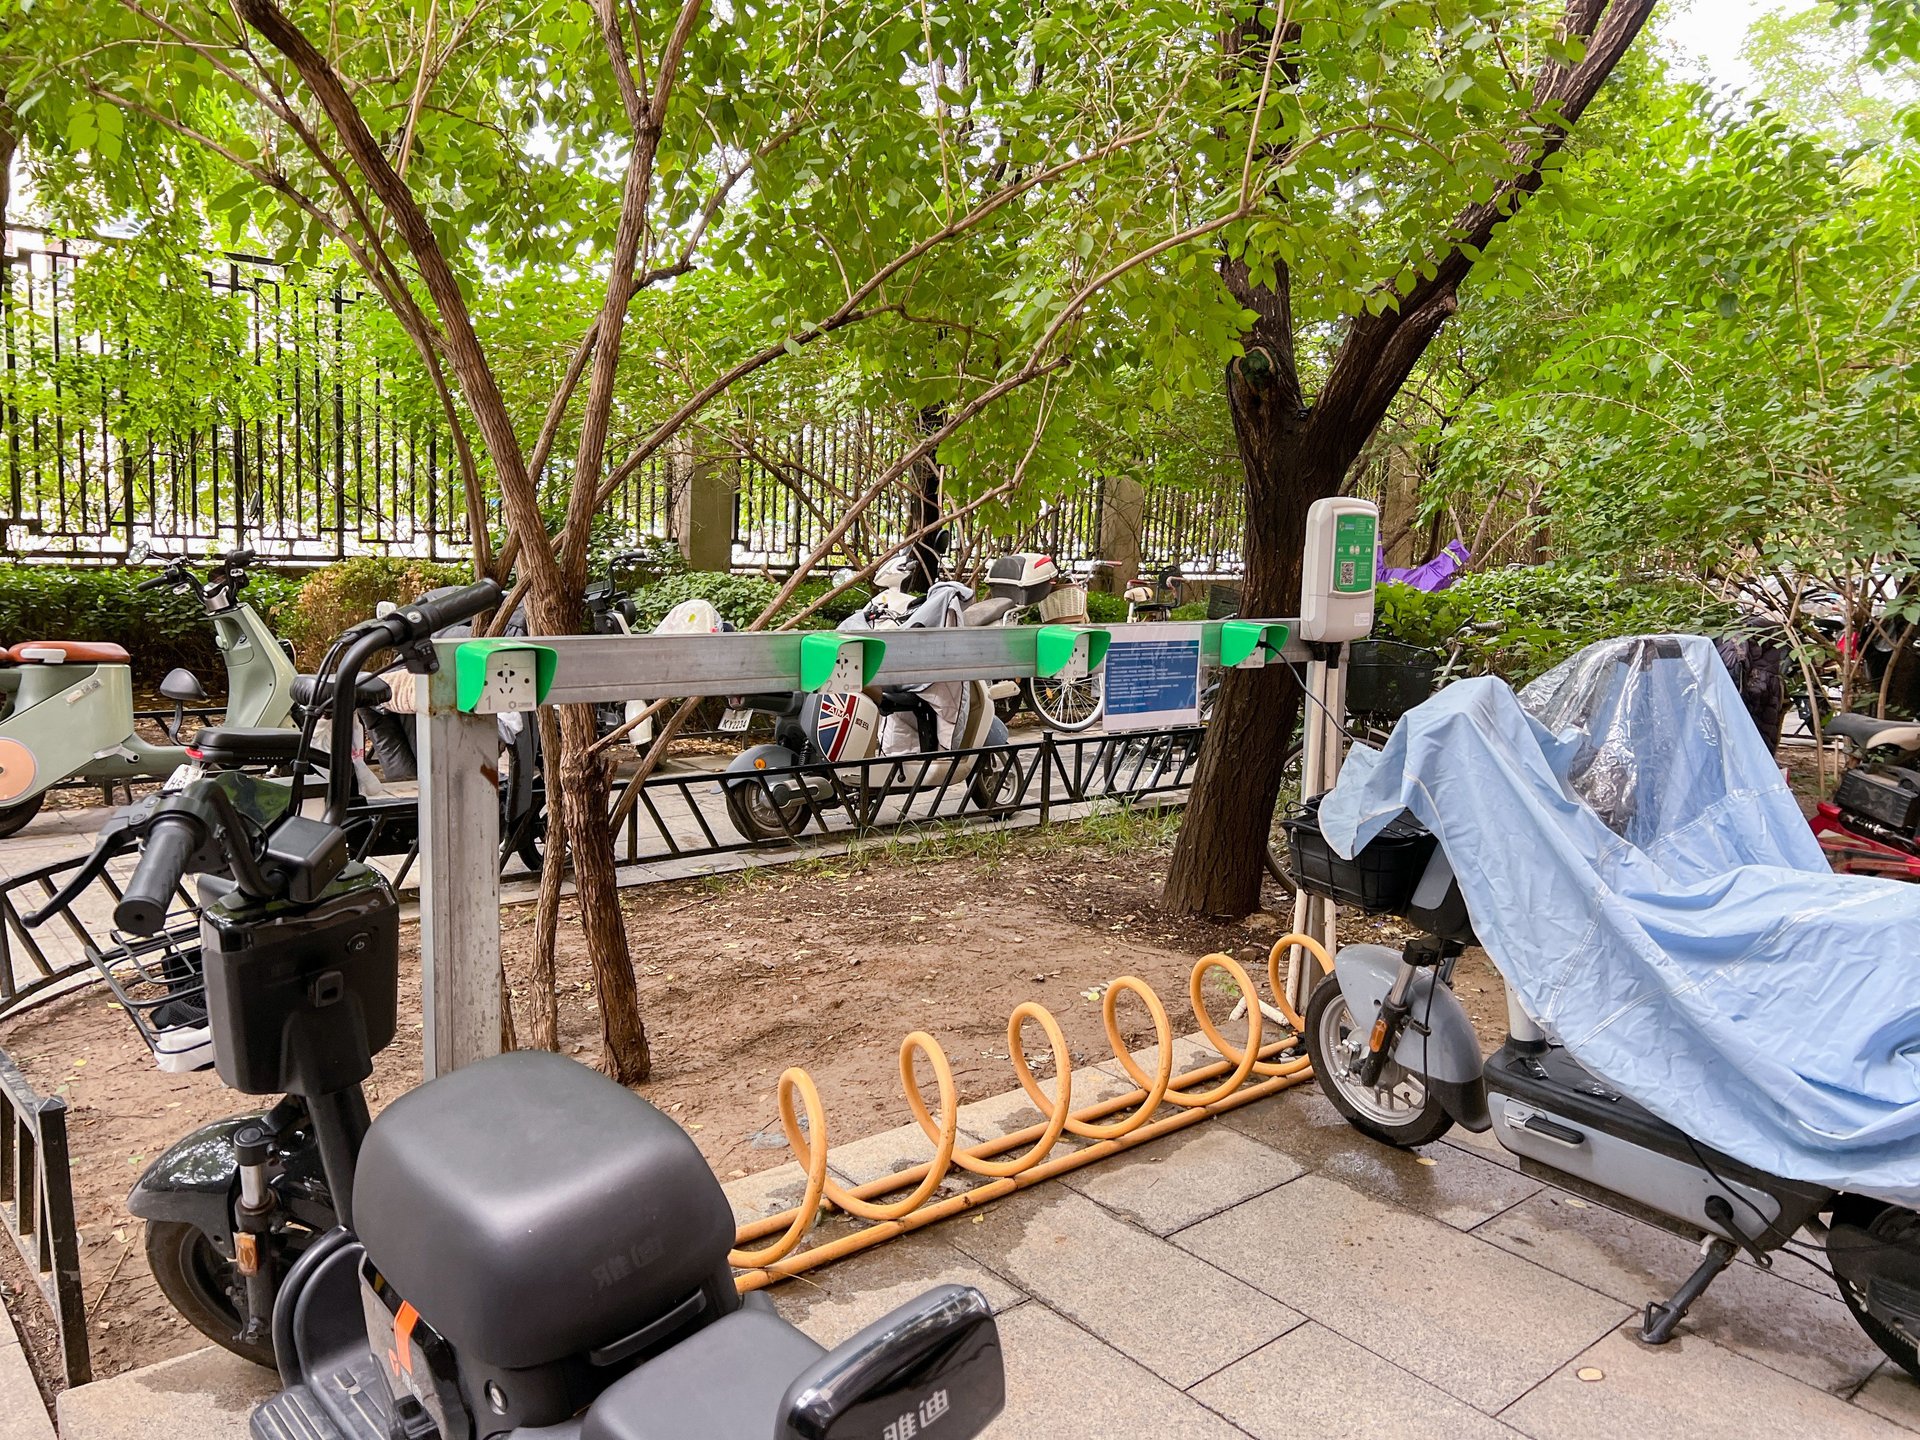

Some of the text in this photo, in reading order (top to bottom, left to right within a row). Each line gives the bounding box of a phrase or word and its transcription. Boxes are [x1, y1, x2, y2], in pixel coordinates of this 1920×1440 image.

[827, 680, 833, 693] 2
[485, 695, 492, 711] 1
[828, 706, 850, 721] AIMA
[883, 1389, 949, 1440] 雅迪
